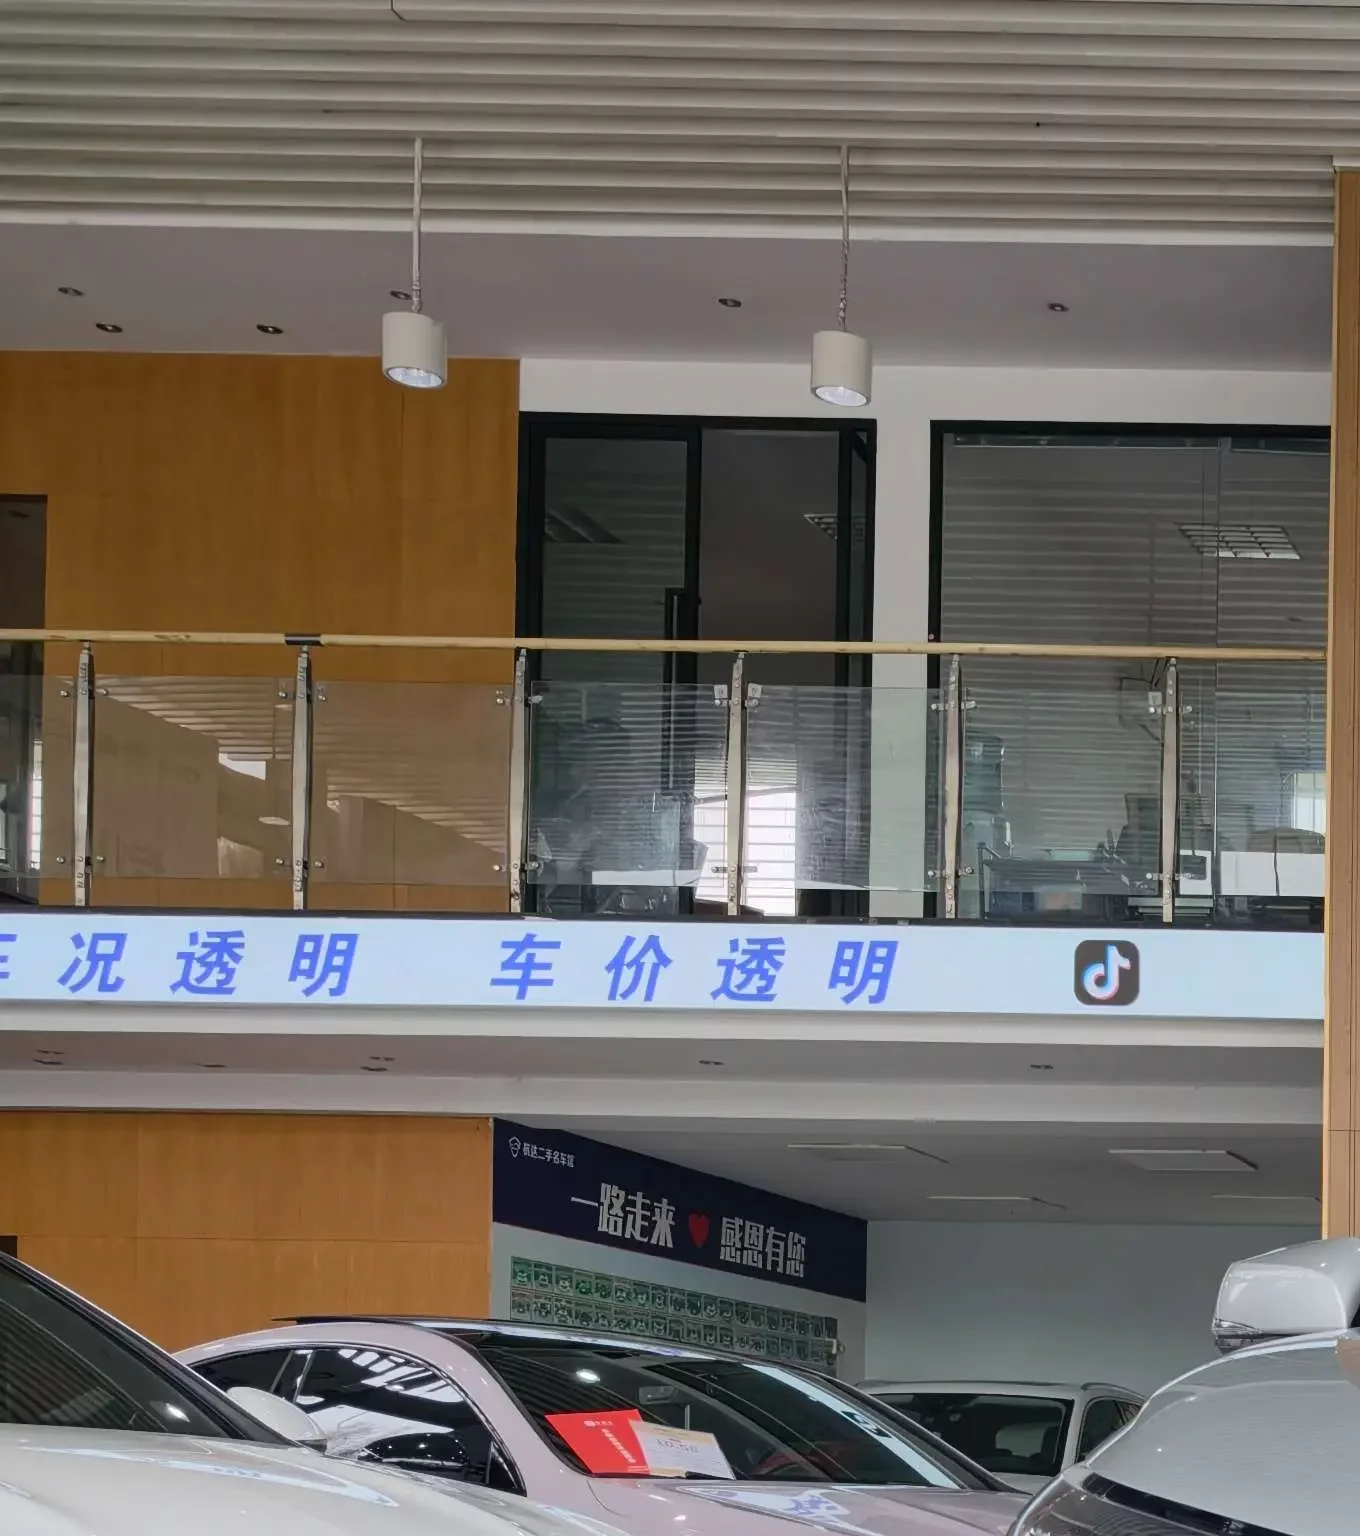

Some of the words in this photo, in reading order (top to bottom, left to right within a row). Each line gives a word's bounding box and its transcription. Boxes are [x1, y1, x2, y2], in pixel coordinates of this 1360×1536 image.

[0, 930, 358, 995] 况透明
[489, 933, 898, 1003] 车价透明
[570, 1182, 676, 1248] 一路走来
[719, 1216, 806, 1278] 感恩有您
